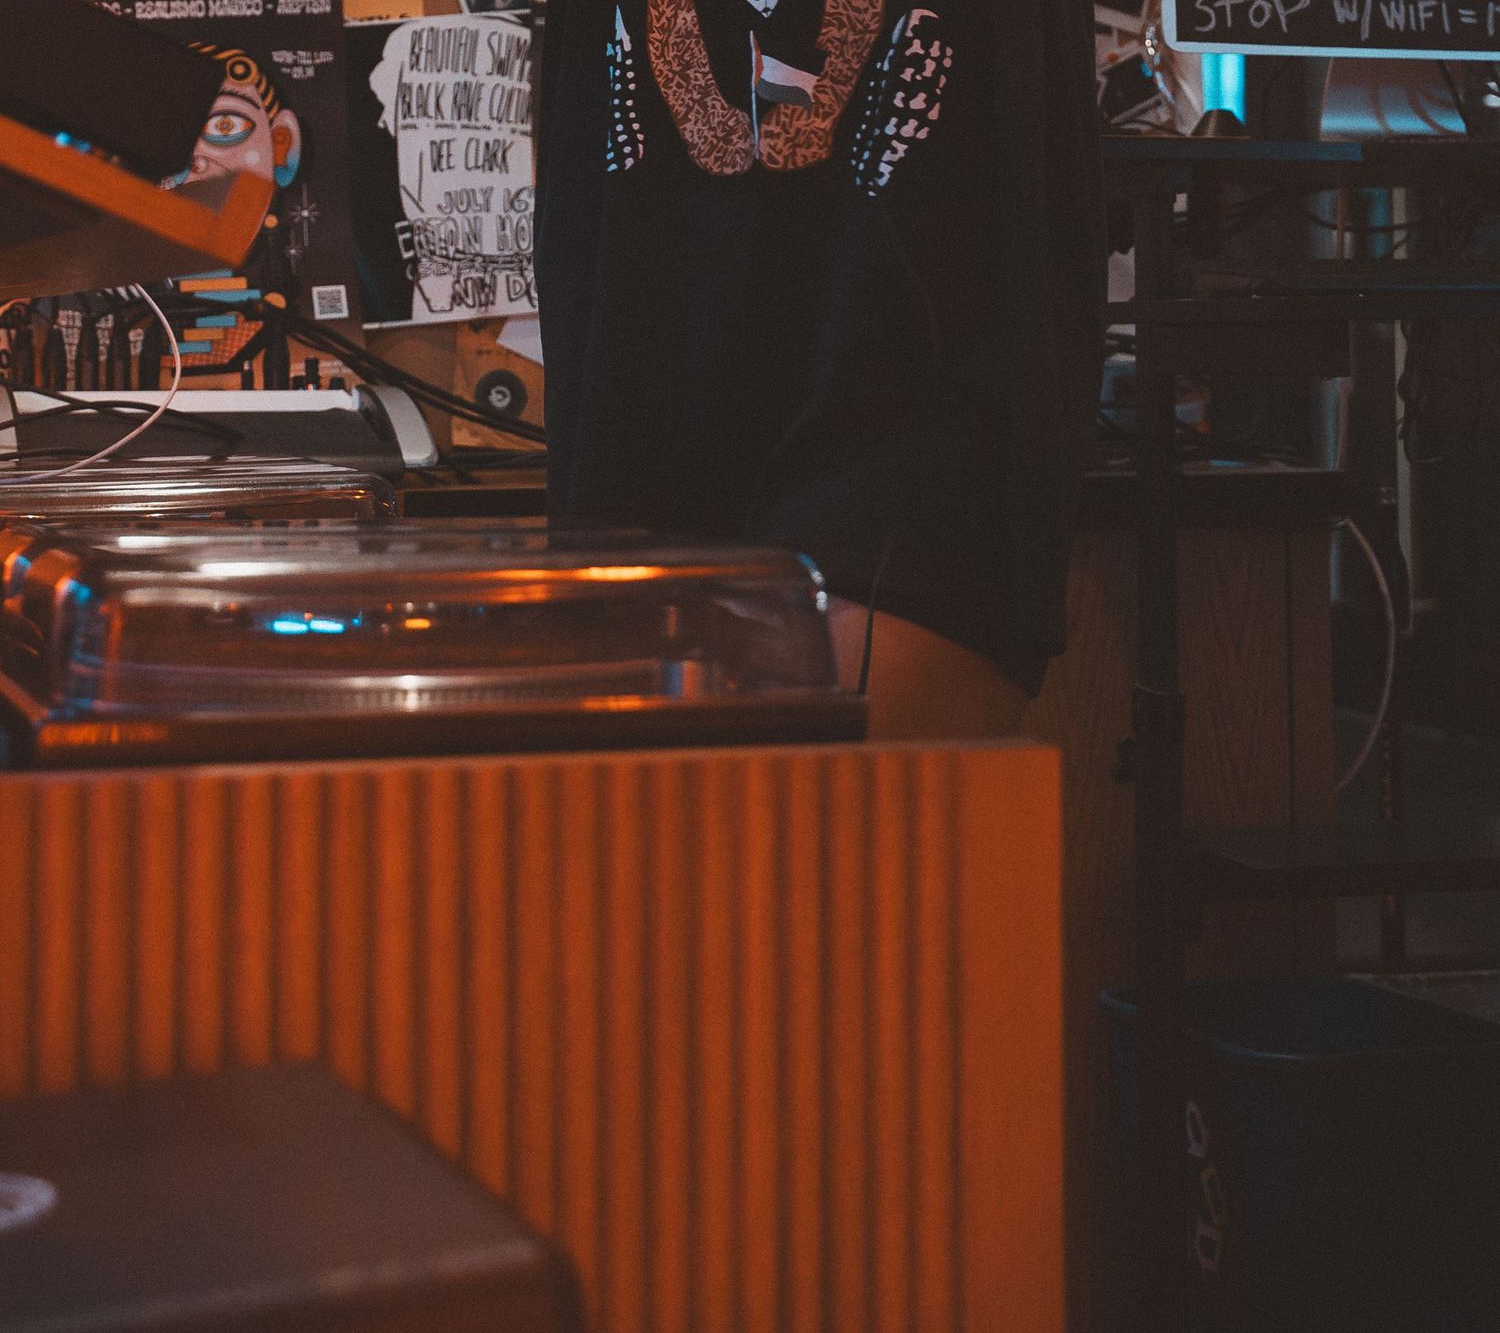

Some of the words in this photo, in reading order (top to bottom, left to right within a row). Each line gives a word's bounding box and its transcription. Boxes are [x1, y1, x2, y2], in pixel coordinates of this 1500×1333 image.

[409, 26, 480, 77] BEAUTIFUL
[400, 80, 447, 120] BLACK
[450, 80, 486, 122] RAVE
[429, 138, 455, 173] DEE
[464, 137, 515, 175] CLARK
[437, 186, 494, 214] JULY
